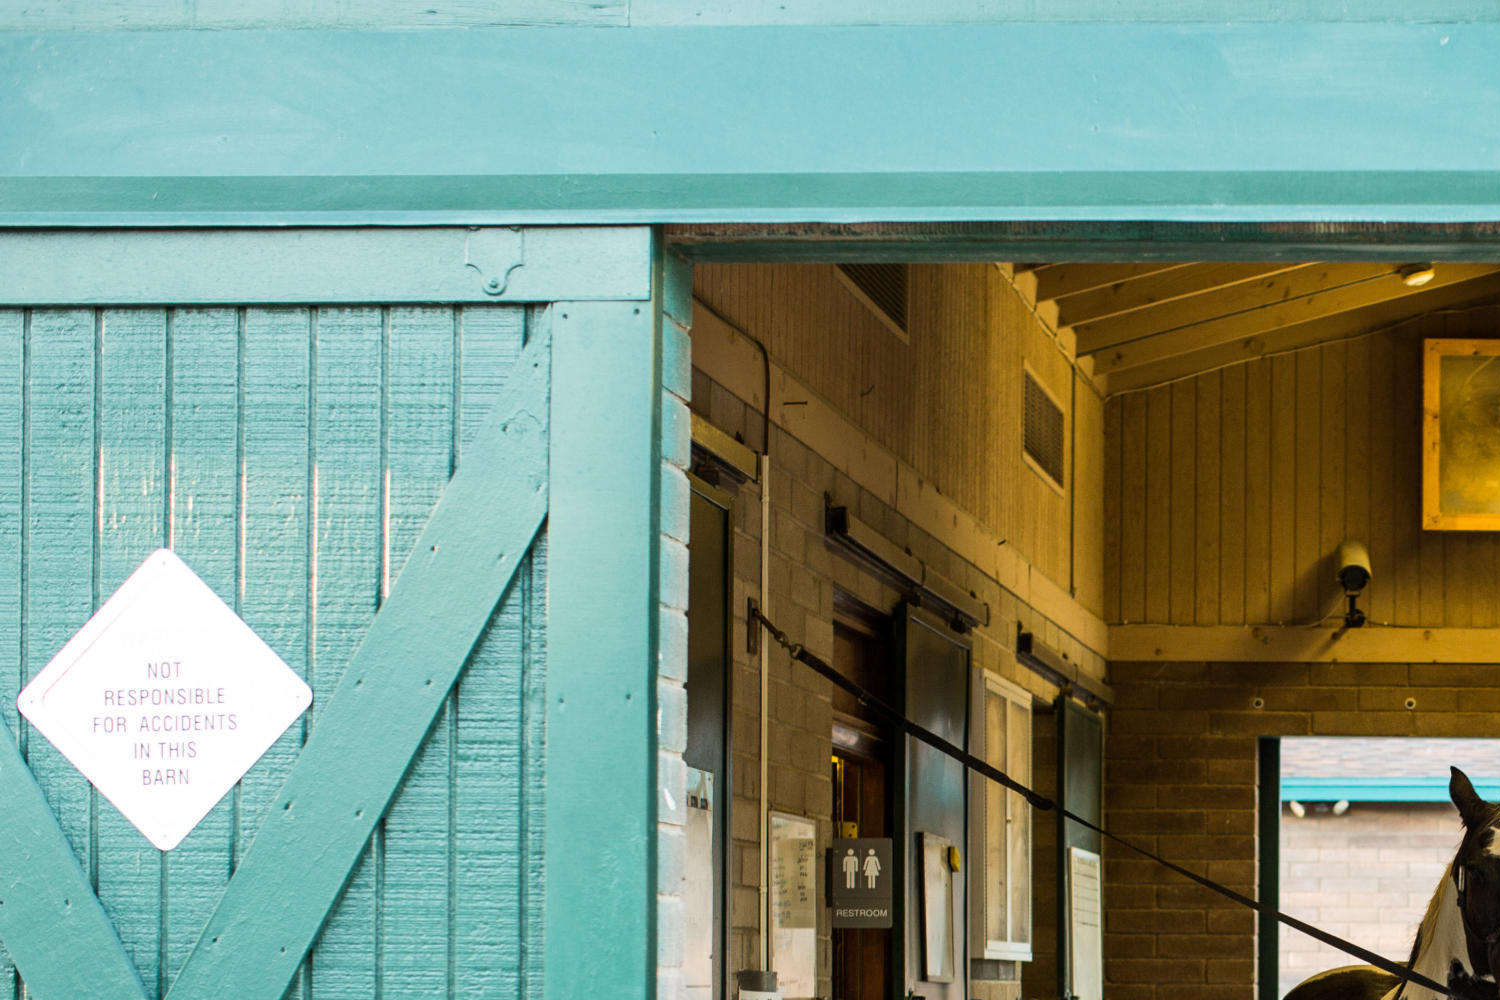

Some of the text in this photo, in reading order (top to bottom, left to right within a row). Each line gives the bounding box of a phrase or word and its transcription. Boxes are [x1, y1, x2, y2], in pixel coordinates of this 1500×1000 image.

[147, 661, 182, 680] NOT
[103, 687, 225, 707] RESPONSIBLE
[93, 713, 238, 734] FOR ACCIDENTS
[133, 741, 197, 760] IN THIS
[142, 768, 189, 787] BARN
[836, 908, 888, 918] RESTROOM
